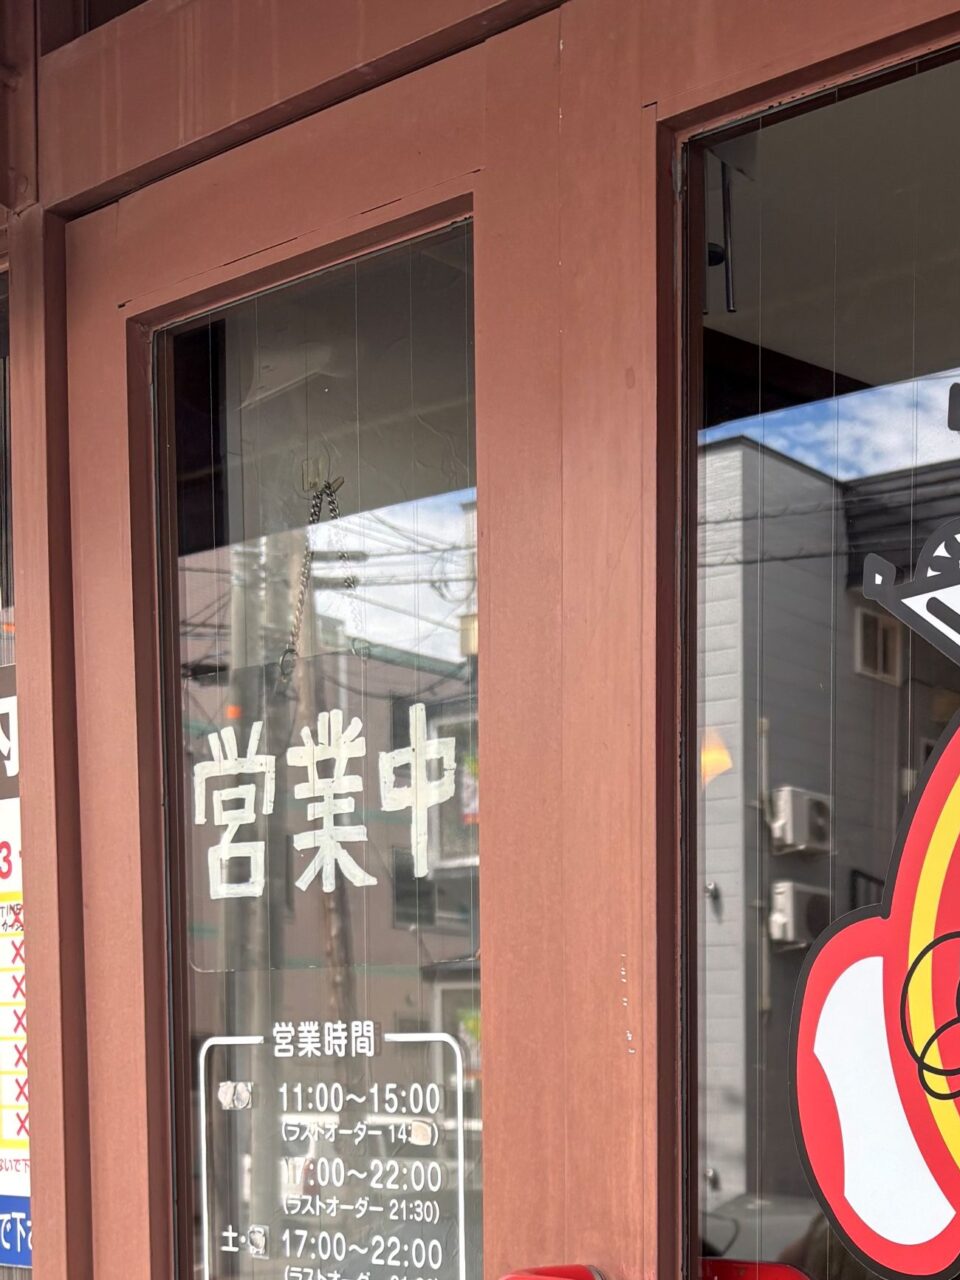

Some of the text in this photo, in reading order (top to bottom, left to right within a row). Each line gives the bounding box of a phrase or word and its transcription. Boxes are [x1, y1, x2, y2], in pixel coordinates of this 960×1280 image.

[194, 702, 457, 900] 営業中
[272, 1020, 375, 1058] 営業時間
